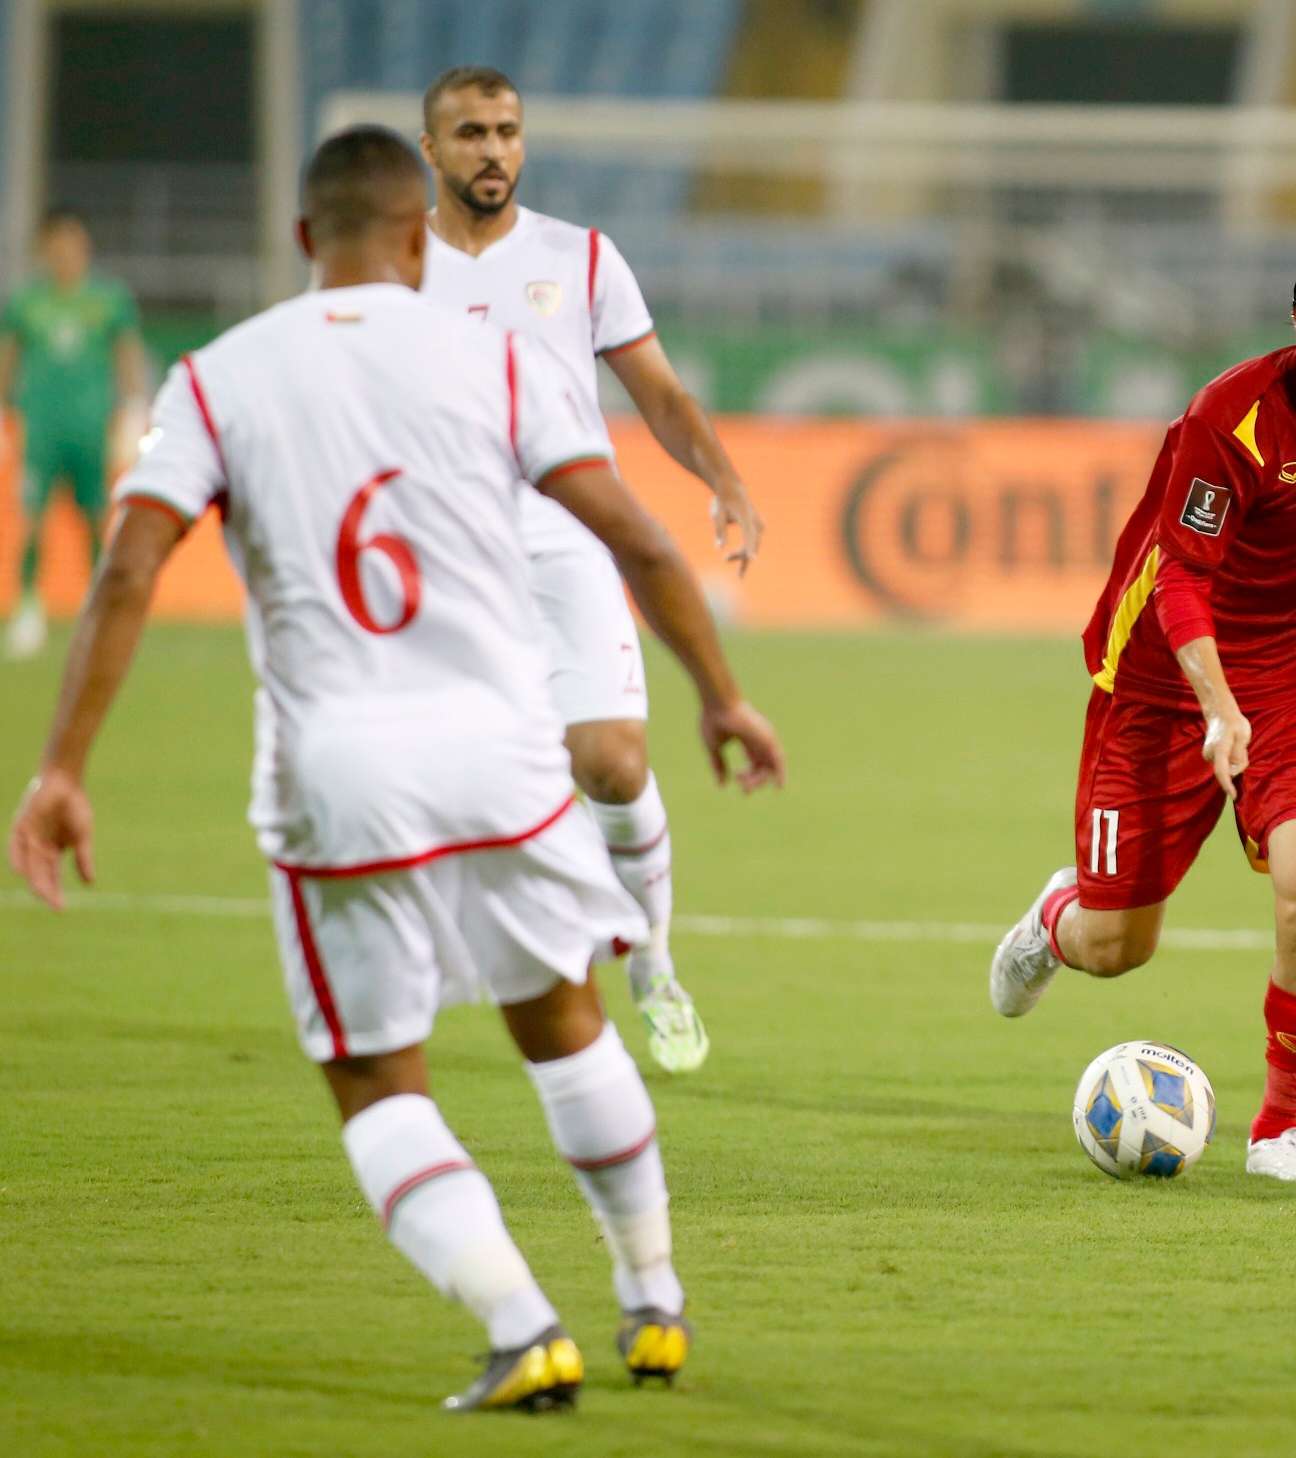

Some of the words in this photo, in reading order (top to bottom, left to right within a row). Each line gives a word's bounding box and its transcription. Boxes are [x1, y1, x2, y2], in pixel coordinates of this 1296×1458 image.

[336, 467, 422, 636] 6
[1091, 807, 1120, 876] 11
[1141, 1047, 1194, 1075] molten
